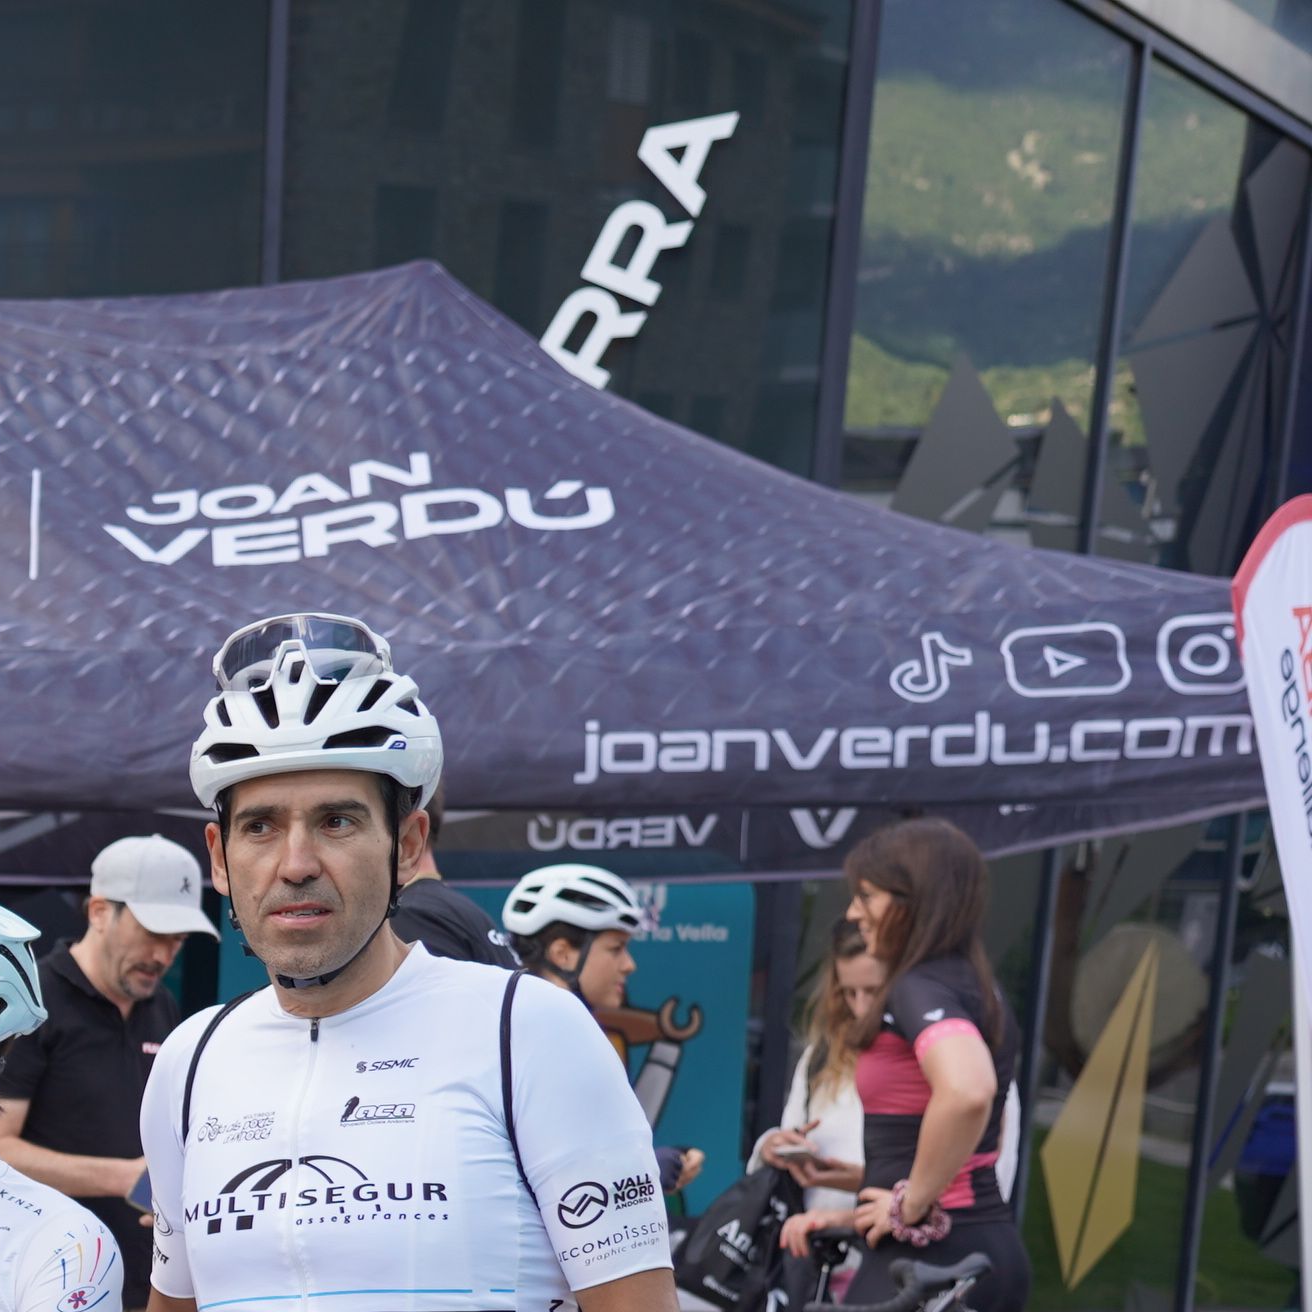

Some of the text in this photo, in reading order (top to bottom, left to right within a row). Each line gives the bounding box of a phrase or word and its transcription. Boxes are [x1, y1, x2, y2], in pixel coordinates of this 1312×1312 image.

[126, 452, 432, 527] JOAN
[102, 480, 616, 568] VERDÚ
[575, 712, 1253, 784] joanverdu.com
[368, 1057, 420, 1071] SISMIC
[613, 1173, 652, 1192] VALL
[613, 1184, 655, 1204] NORD
[184, 1182, 448, 1226] MULTISEGUR
[295, 1211, 449, 1225] assegurances
[584, 1236, 660, 1266] graphic design
